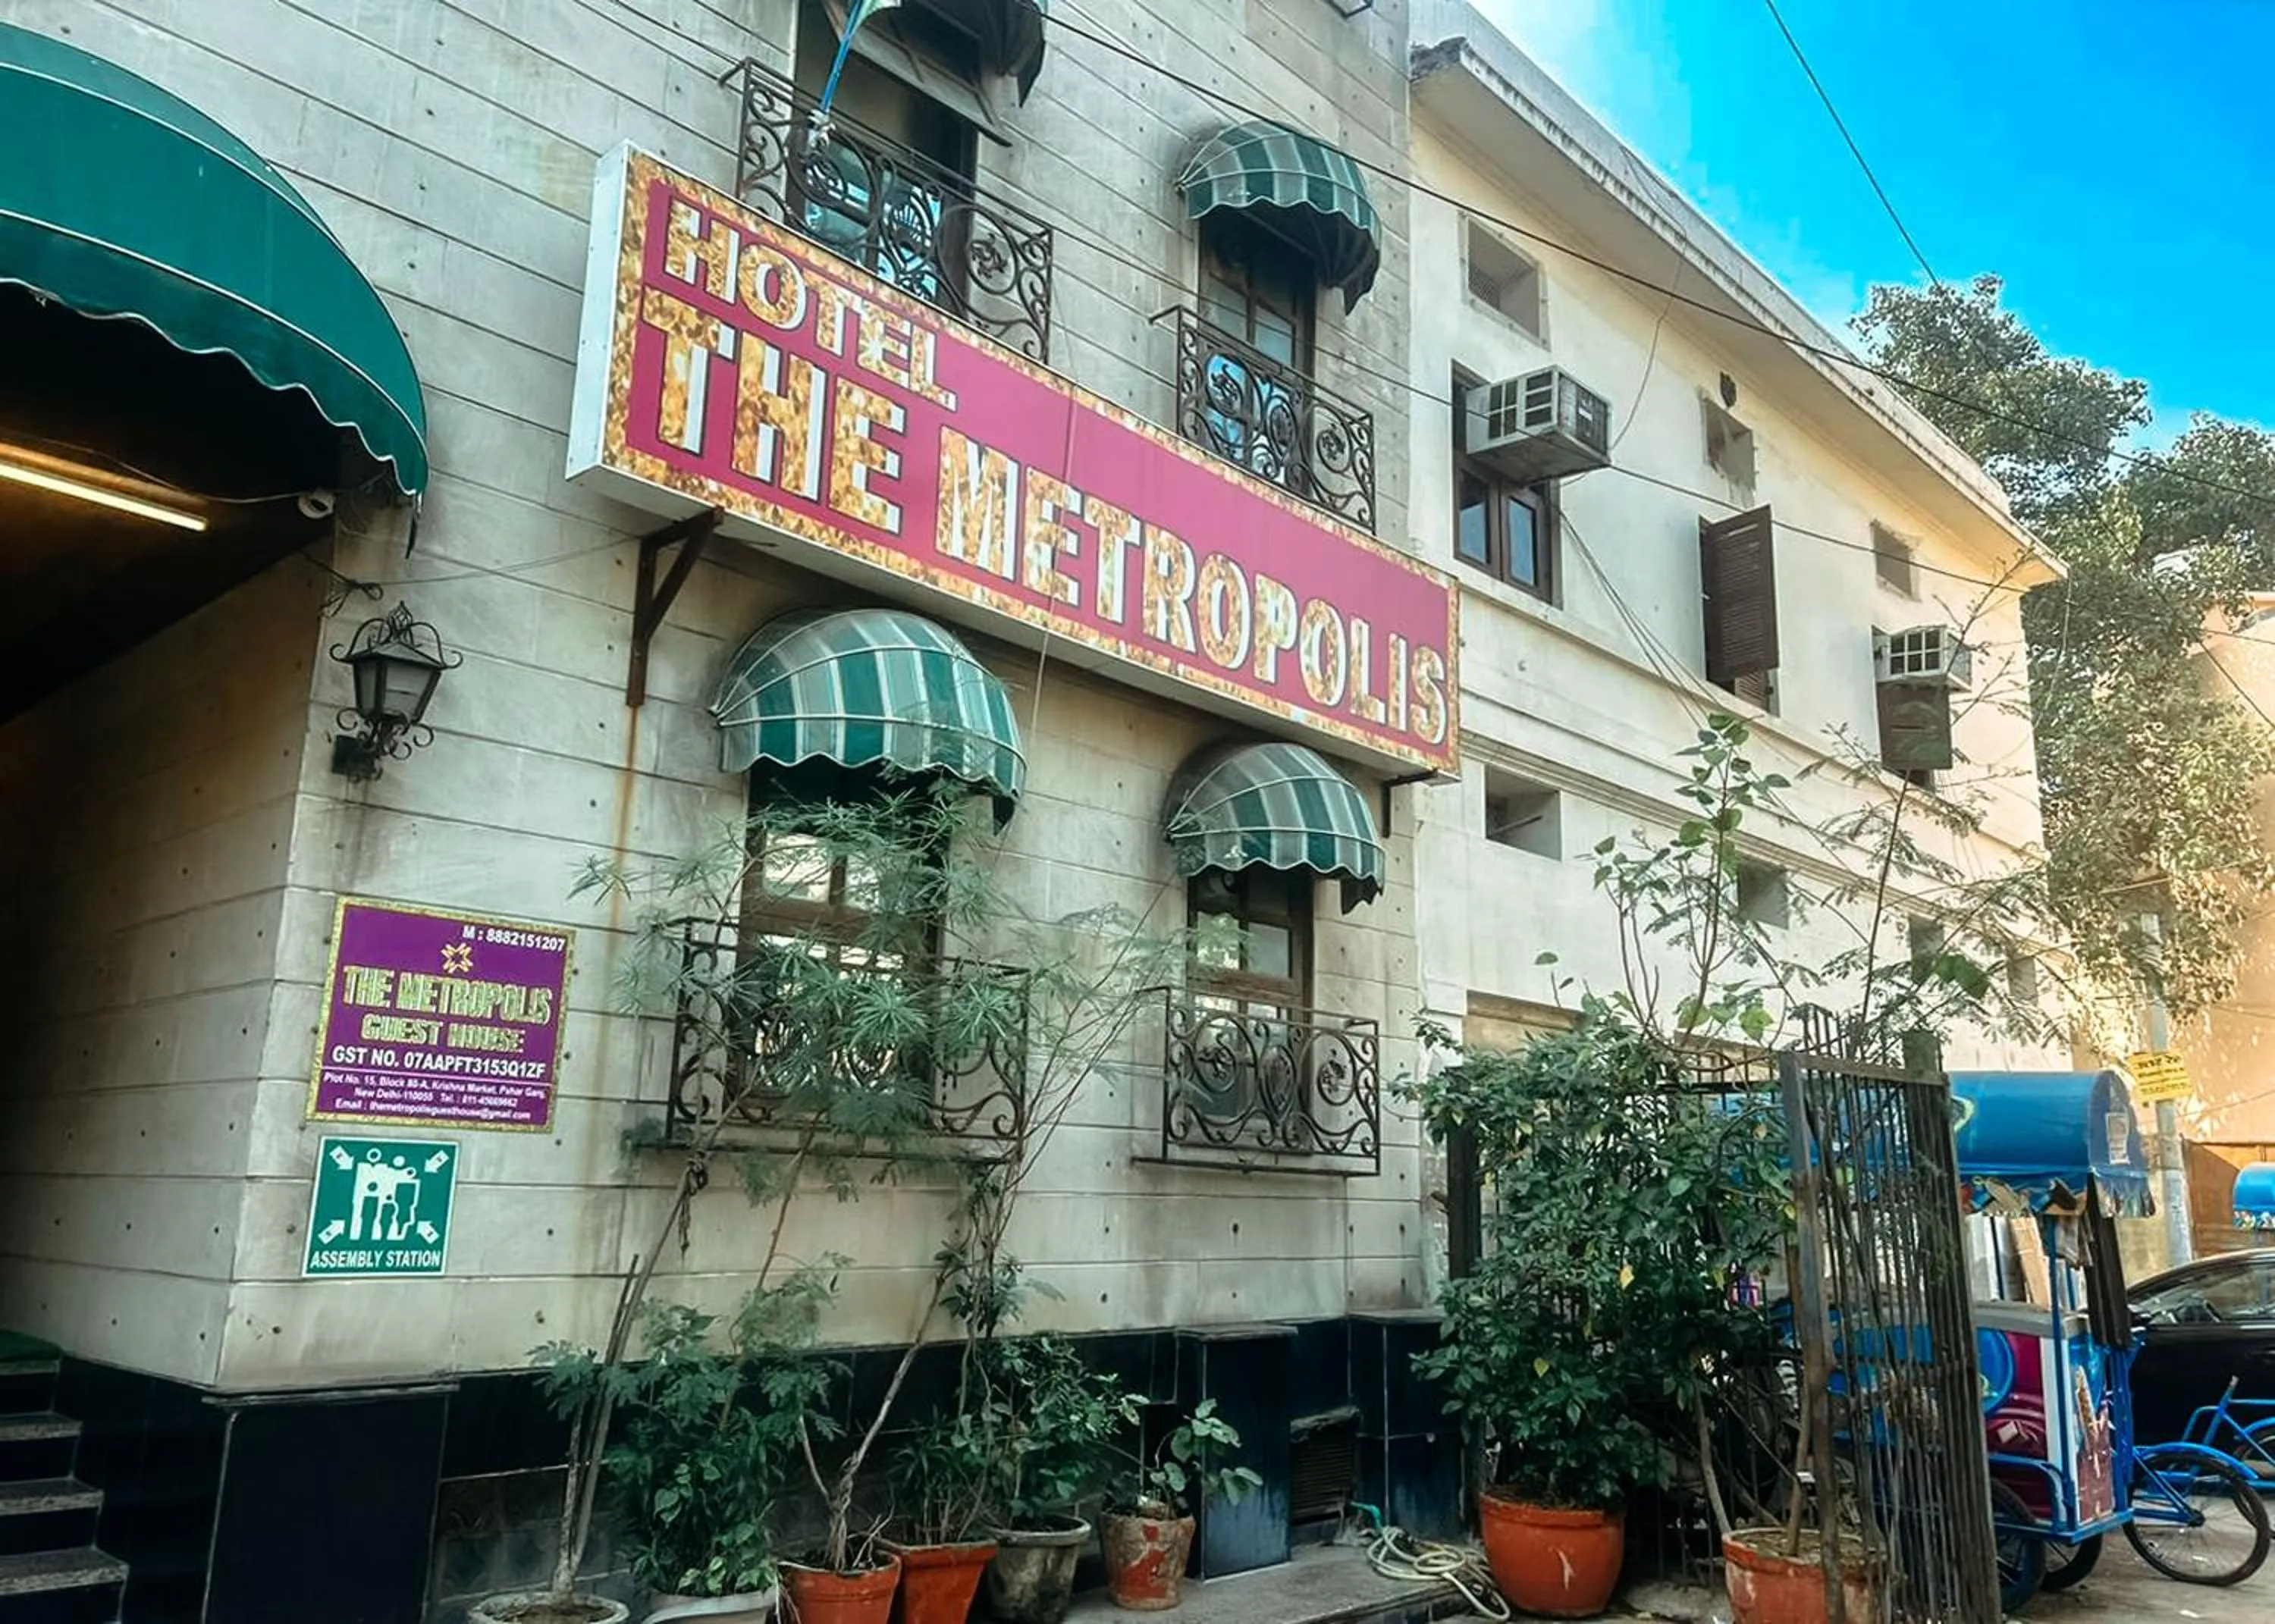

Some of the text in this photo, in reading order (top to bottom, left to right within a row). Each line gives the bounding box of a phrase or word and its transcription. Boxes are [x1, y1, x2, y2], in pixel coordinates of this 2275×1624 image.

[664, 196, 958, 413] HOTEL
[642, 284, 1448, 746] THE METROPOLIS
[462, 924, 475, 939] M
[485, 927, 566, 952] 8882151207
[343, 964, 553, 1025] THE METROPOLIS
[361, 1013, 526, 1053] GUEST HOUSE
[332, 1045, 546, 1080] GST NO. 07AAPFT3153Q1ZF
[354, 1086, 375, 1098] New
[309, 1249, 441, 1268] ASSEMBLY STATION
